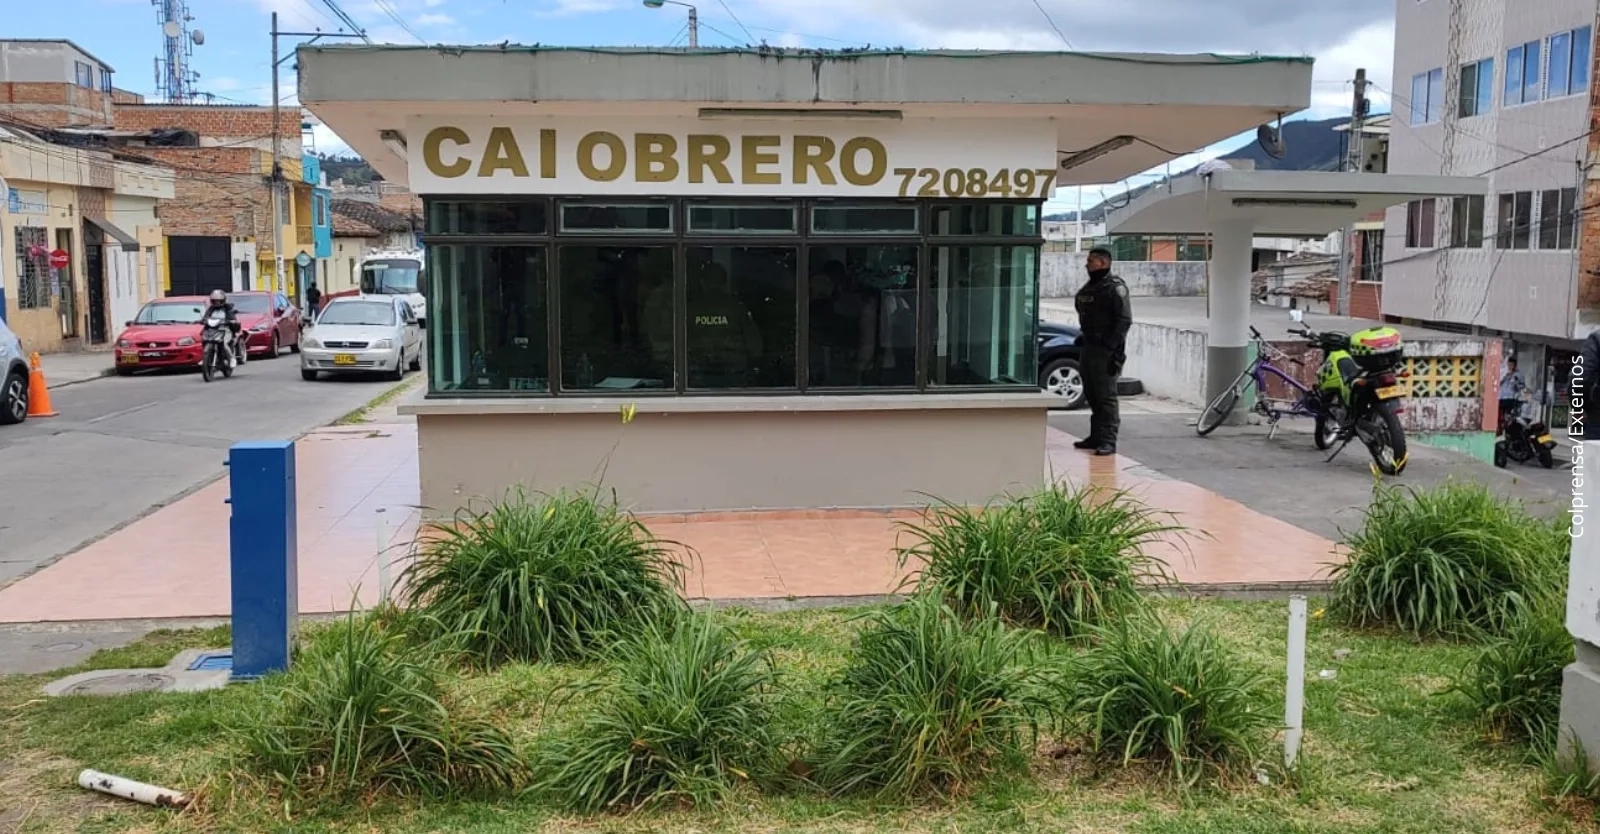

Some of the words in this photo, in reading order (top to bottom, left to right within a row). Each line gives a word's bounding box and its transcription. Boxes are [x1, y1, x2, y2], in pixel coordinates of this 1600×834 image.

[423, 126, 556, 178] CAI
[576, 131, 887, 186] OBRERO
[894, 168, 1057, 198] 7208497
[695, 316, 728, 325] POLICIA
